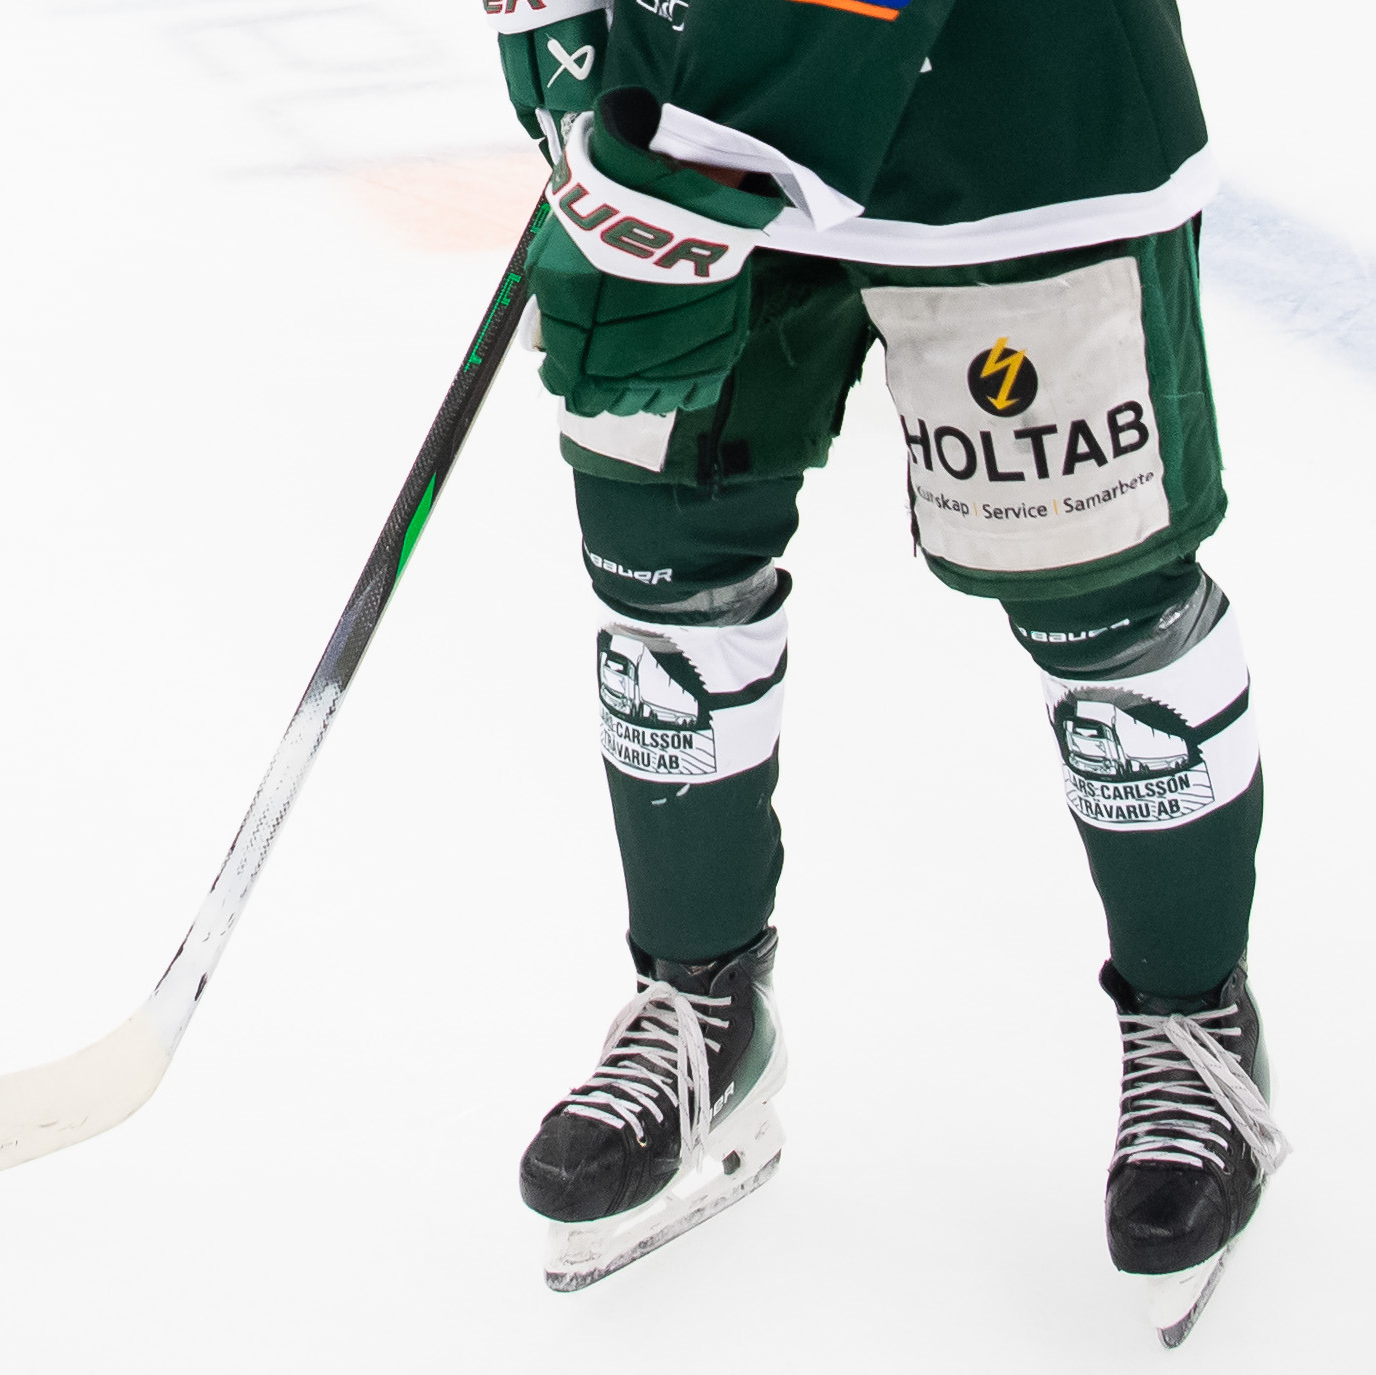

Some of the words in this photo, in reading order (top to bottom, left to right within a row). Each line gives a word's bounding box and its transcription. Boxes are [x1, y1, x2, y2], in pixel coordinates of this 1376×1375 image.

[900, 399, 1150, 483] HOLTAB
[982, 503, 1048, 520] Service
[615, 721, 694, 750] CARLSSON
[656, 753, 680, 770] AB
[1099, 772, 1192, 801] CARLSSON
[1077, 794, 1151, 820] TRÄVARU
[1156, 798, 1182, 817] AB
